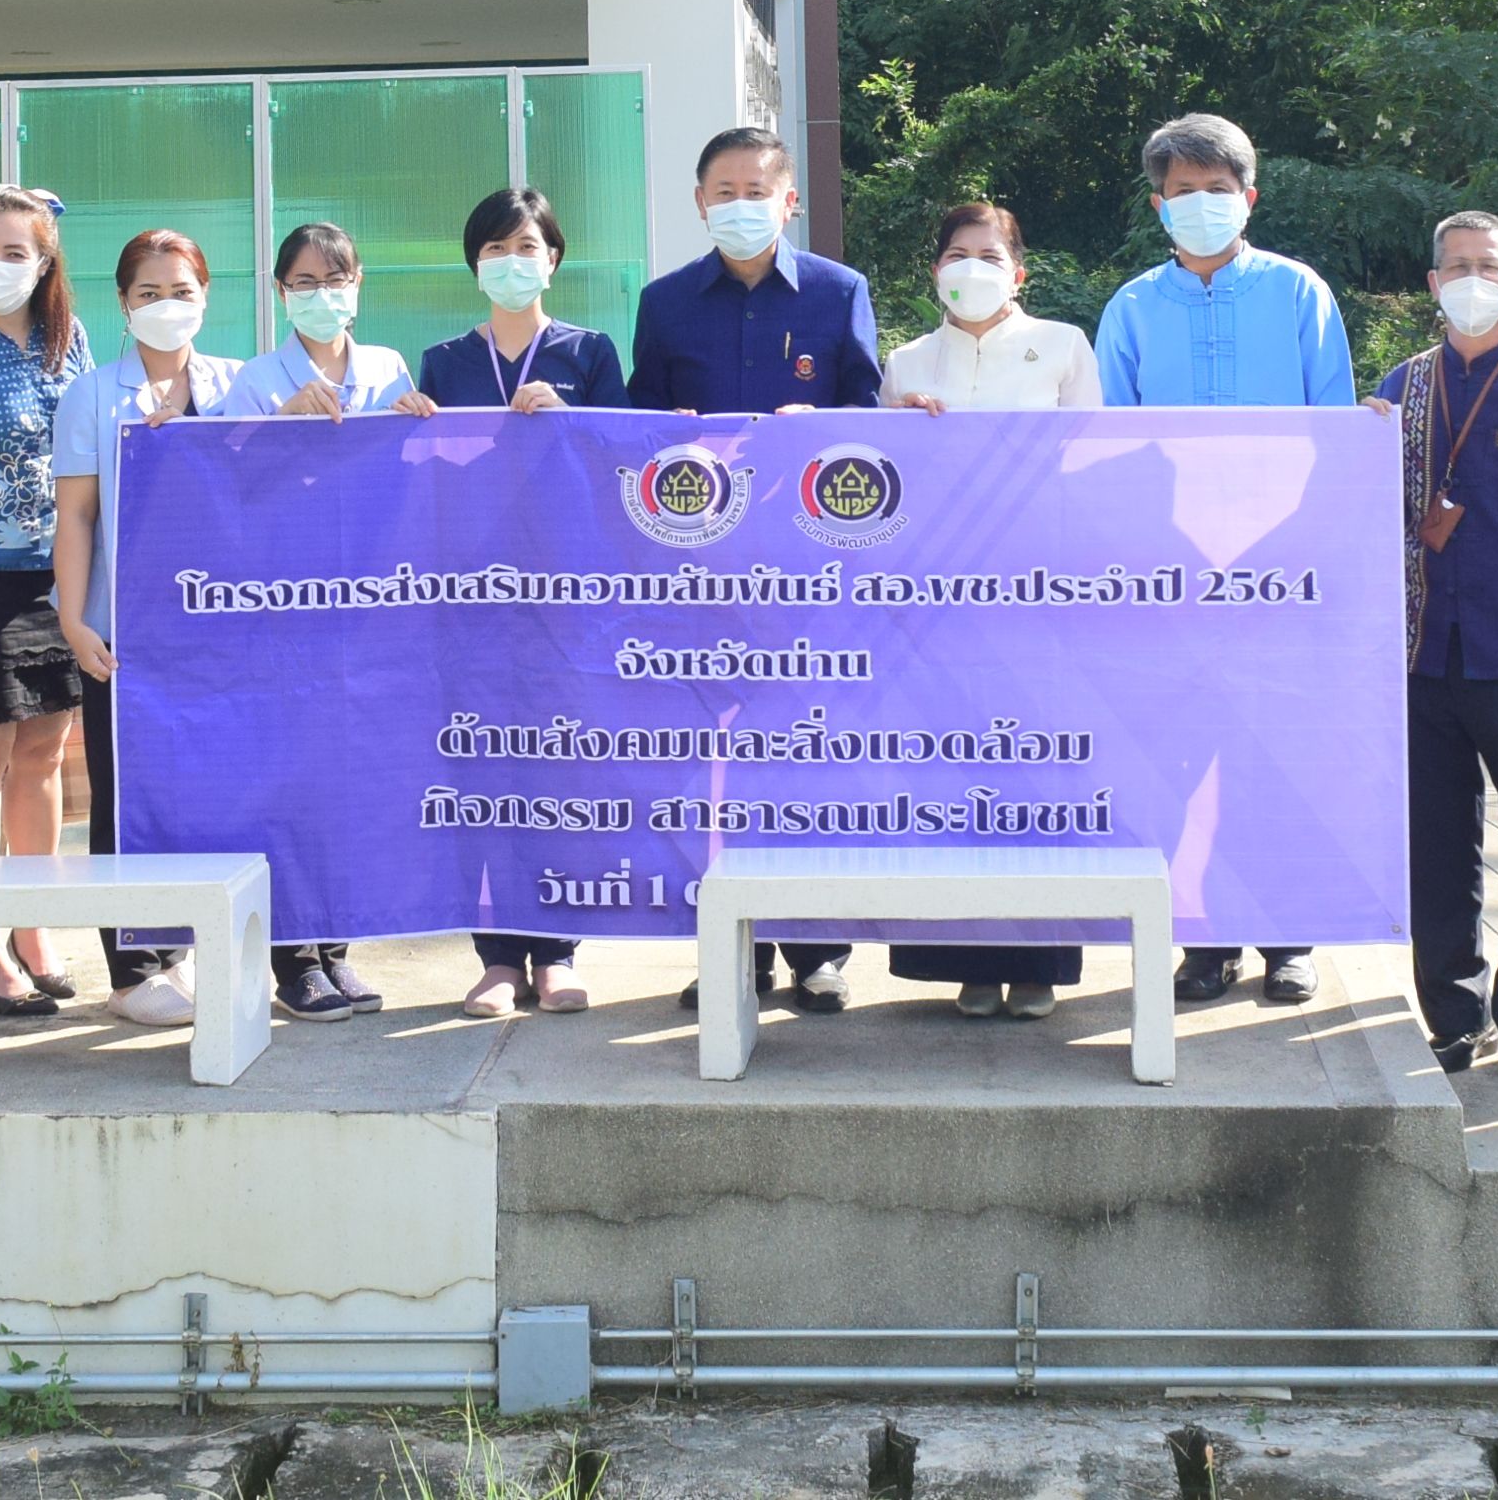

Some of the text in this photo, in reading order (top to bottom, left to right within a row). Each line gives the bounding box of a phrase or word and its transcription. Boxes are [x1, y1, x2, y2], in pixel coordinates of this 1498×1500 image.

[794, 513, 909, 549] กรมการพัฒนาชุมชน
[177, 561, 1319, 612] โครงการส่งเสริมความสัมพันธ์ สอ.พช.ประจำปี 2564
[616, 638, 872, 680] จังหวัดน่าน
[438, 707, 1093, 761] ด้านสังคมและสิ่งแวดล้อม
[420, 786, 1113, 835] กิจกรรม สาธารณประโยชน์
[537, 858, 632, 906] วันที่
[648, 874, 668, 906] 1
